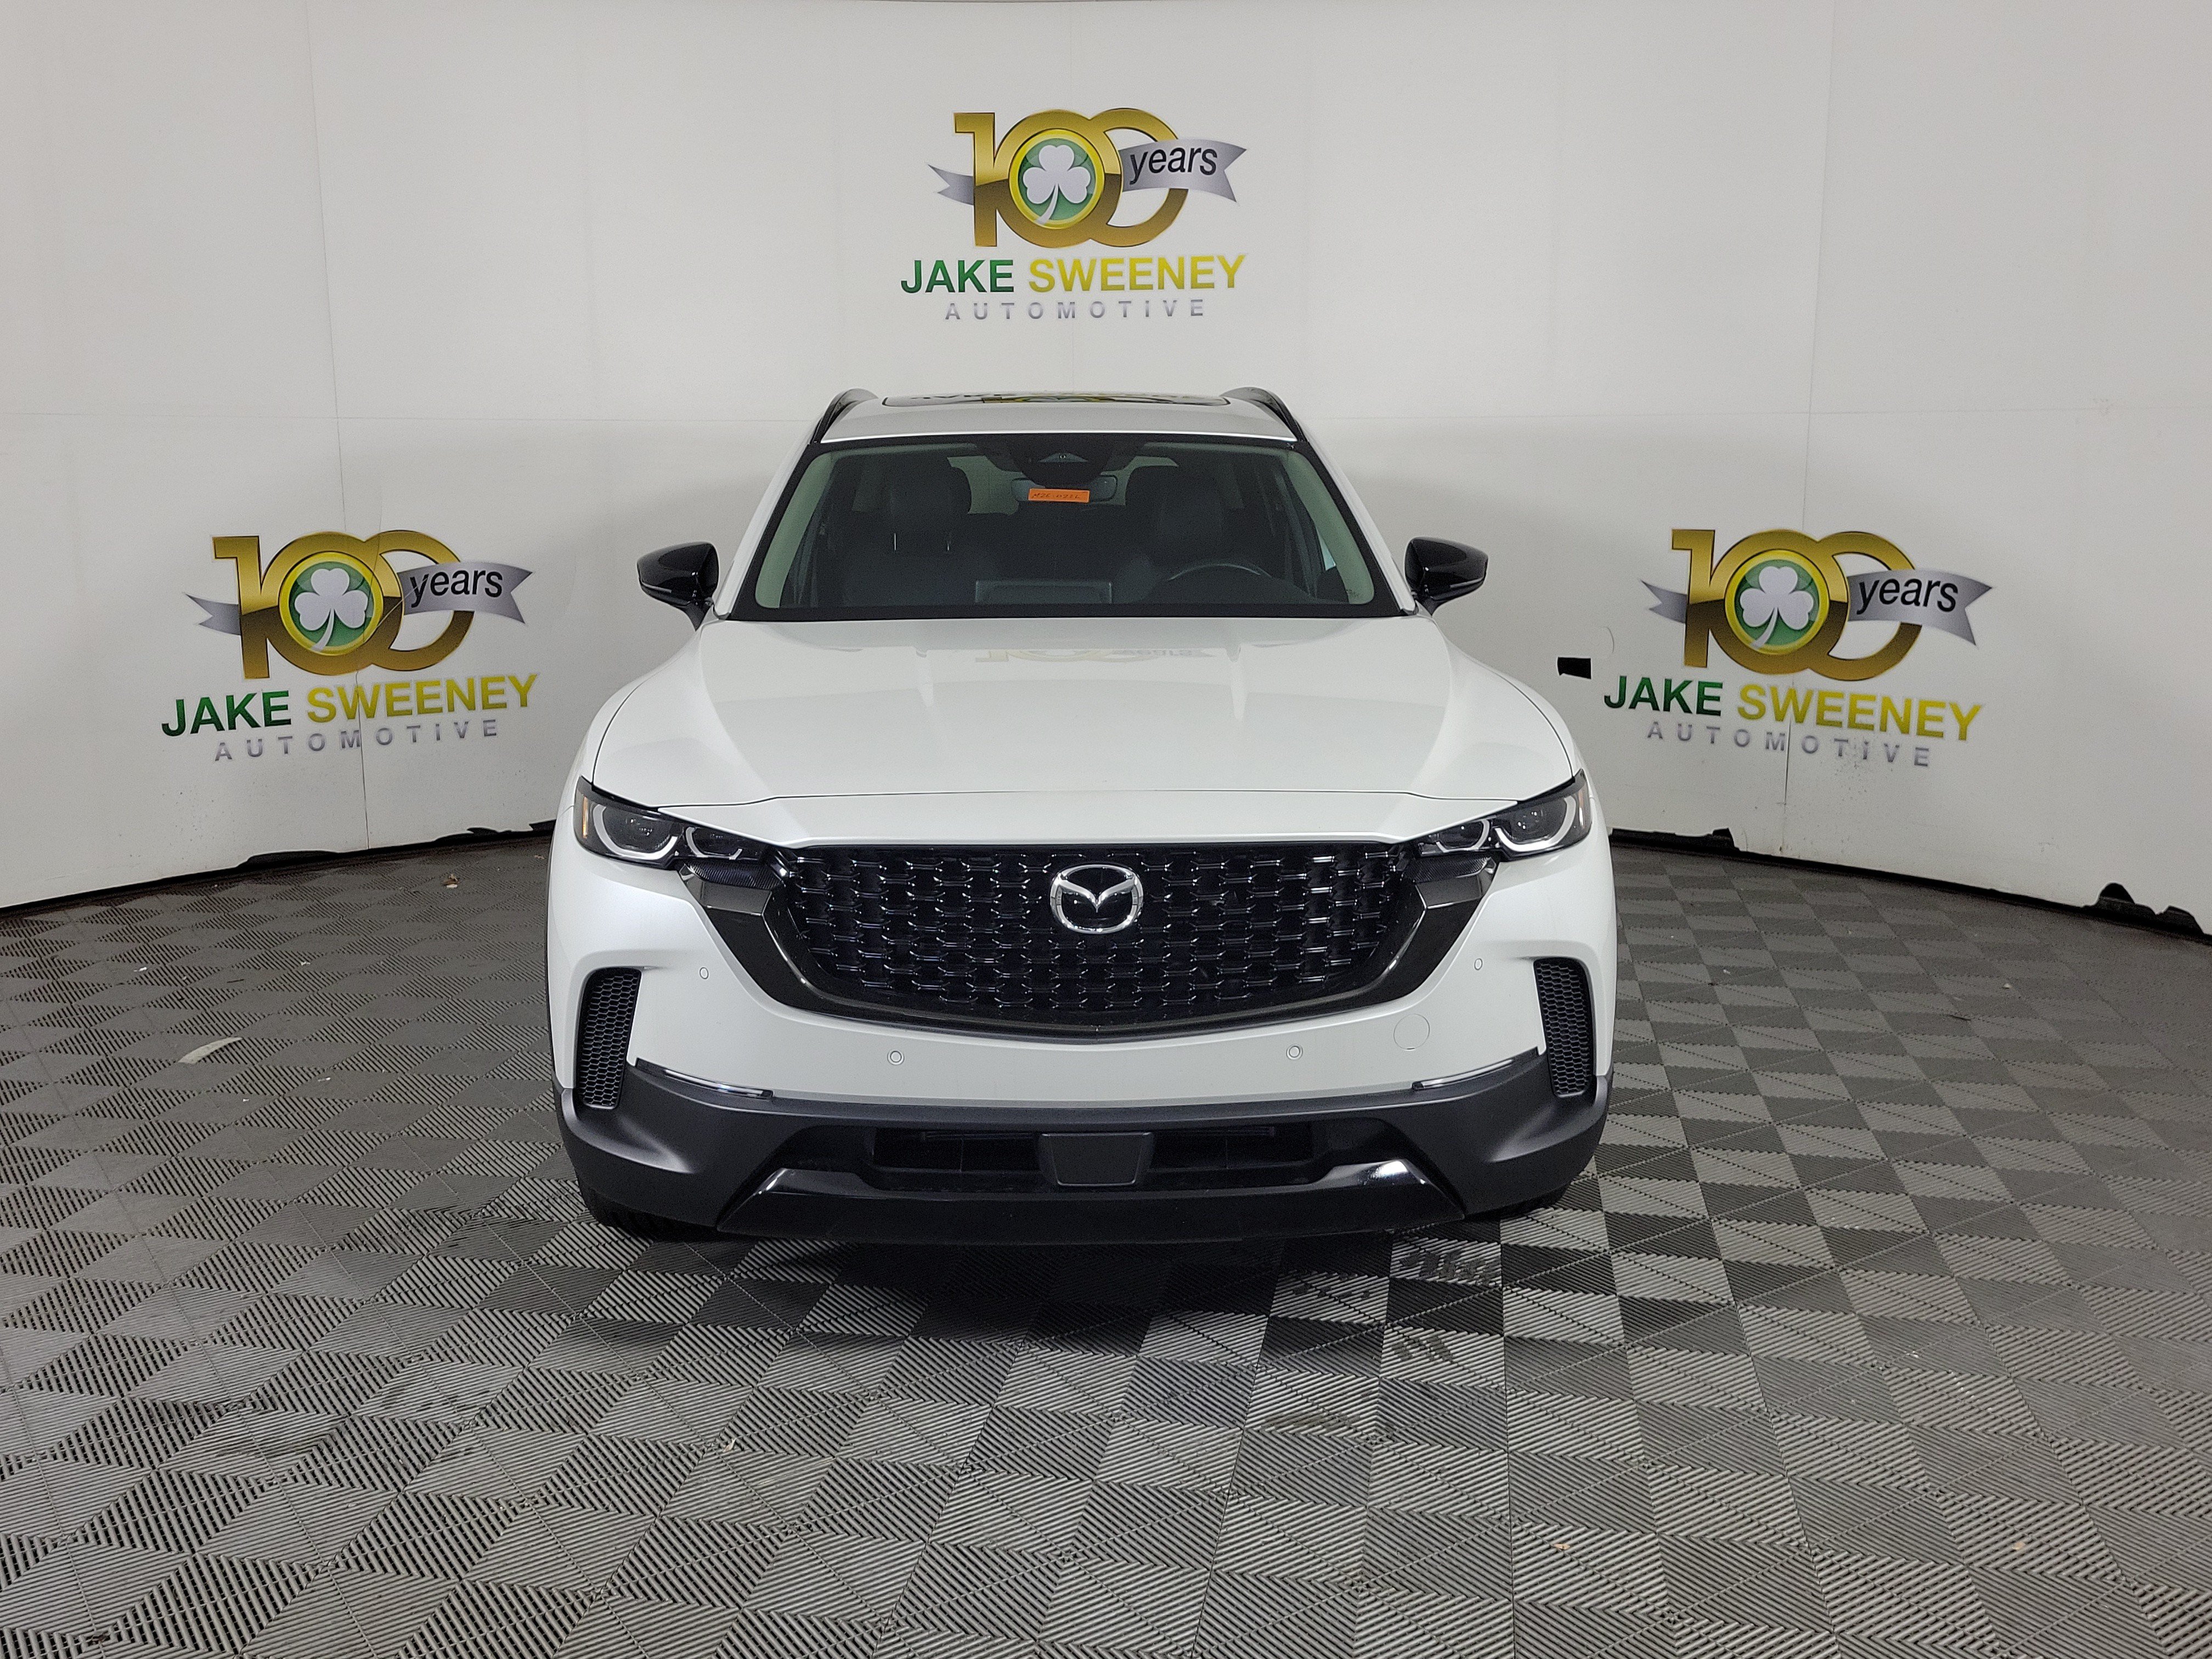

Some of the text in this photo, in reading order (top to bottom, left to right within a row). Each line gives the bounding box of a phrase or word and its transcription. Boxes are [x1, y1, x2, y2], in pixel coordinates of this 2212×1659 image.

[953, 108, 1217, 248] 100 years
[901, 254, 1246, 294] JAKE SWEENEY
[945, 299, 1204, 320] AUTOMOTIVE
[212, 530, 503, 679] 100 years
[1672, 528, 1958, 681] 100 years
[162, 674, 537, 736] JAKE SWEENEY
[1604, 676, 1982, 741] JAKE SWEENEY
[215, 719, 497, 761] AUTOMOTIVE
[1647, 721, 1930, 767] AUTOMOTIVE
